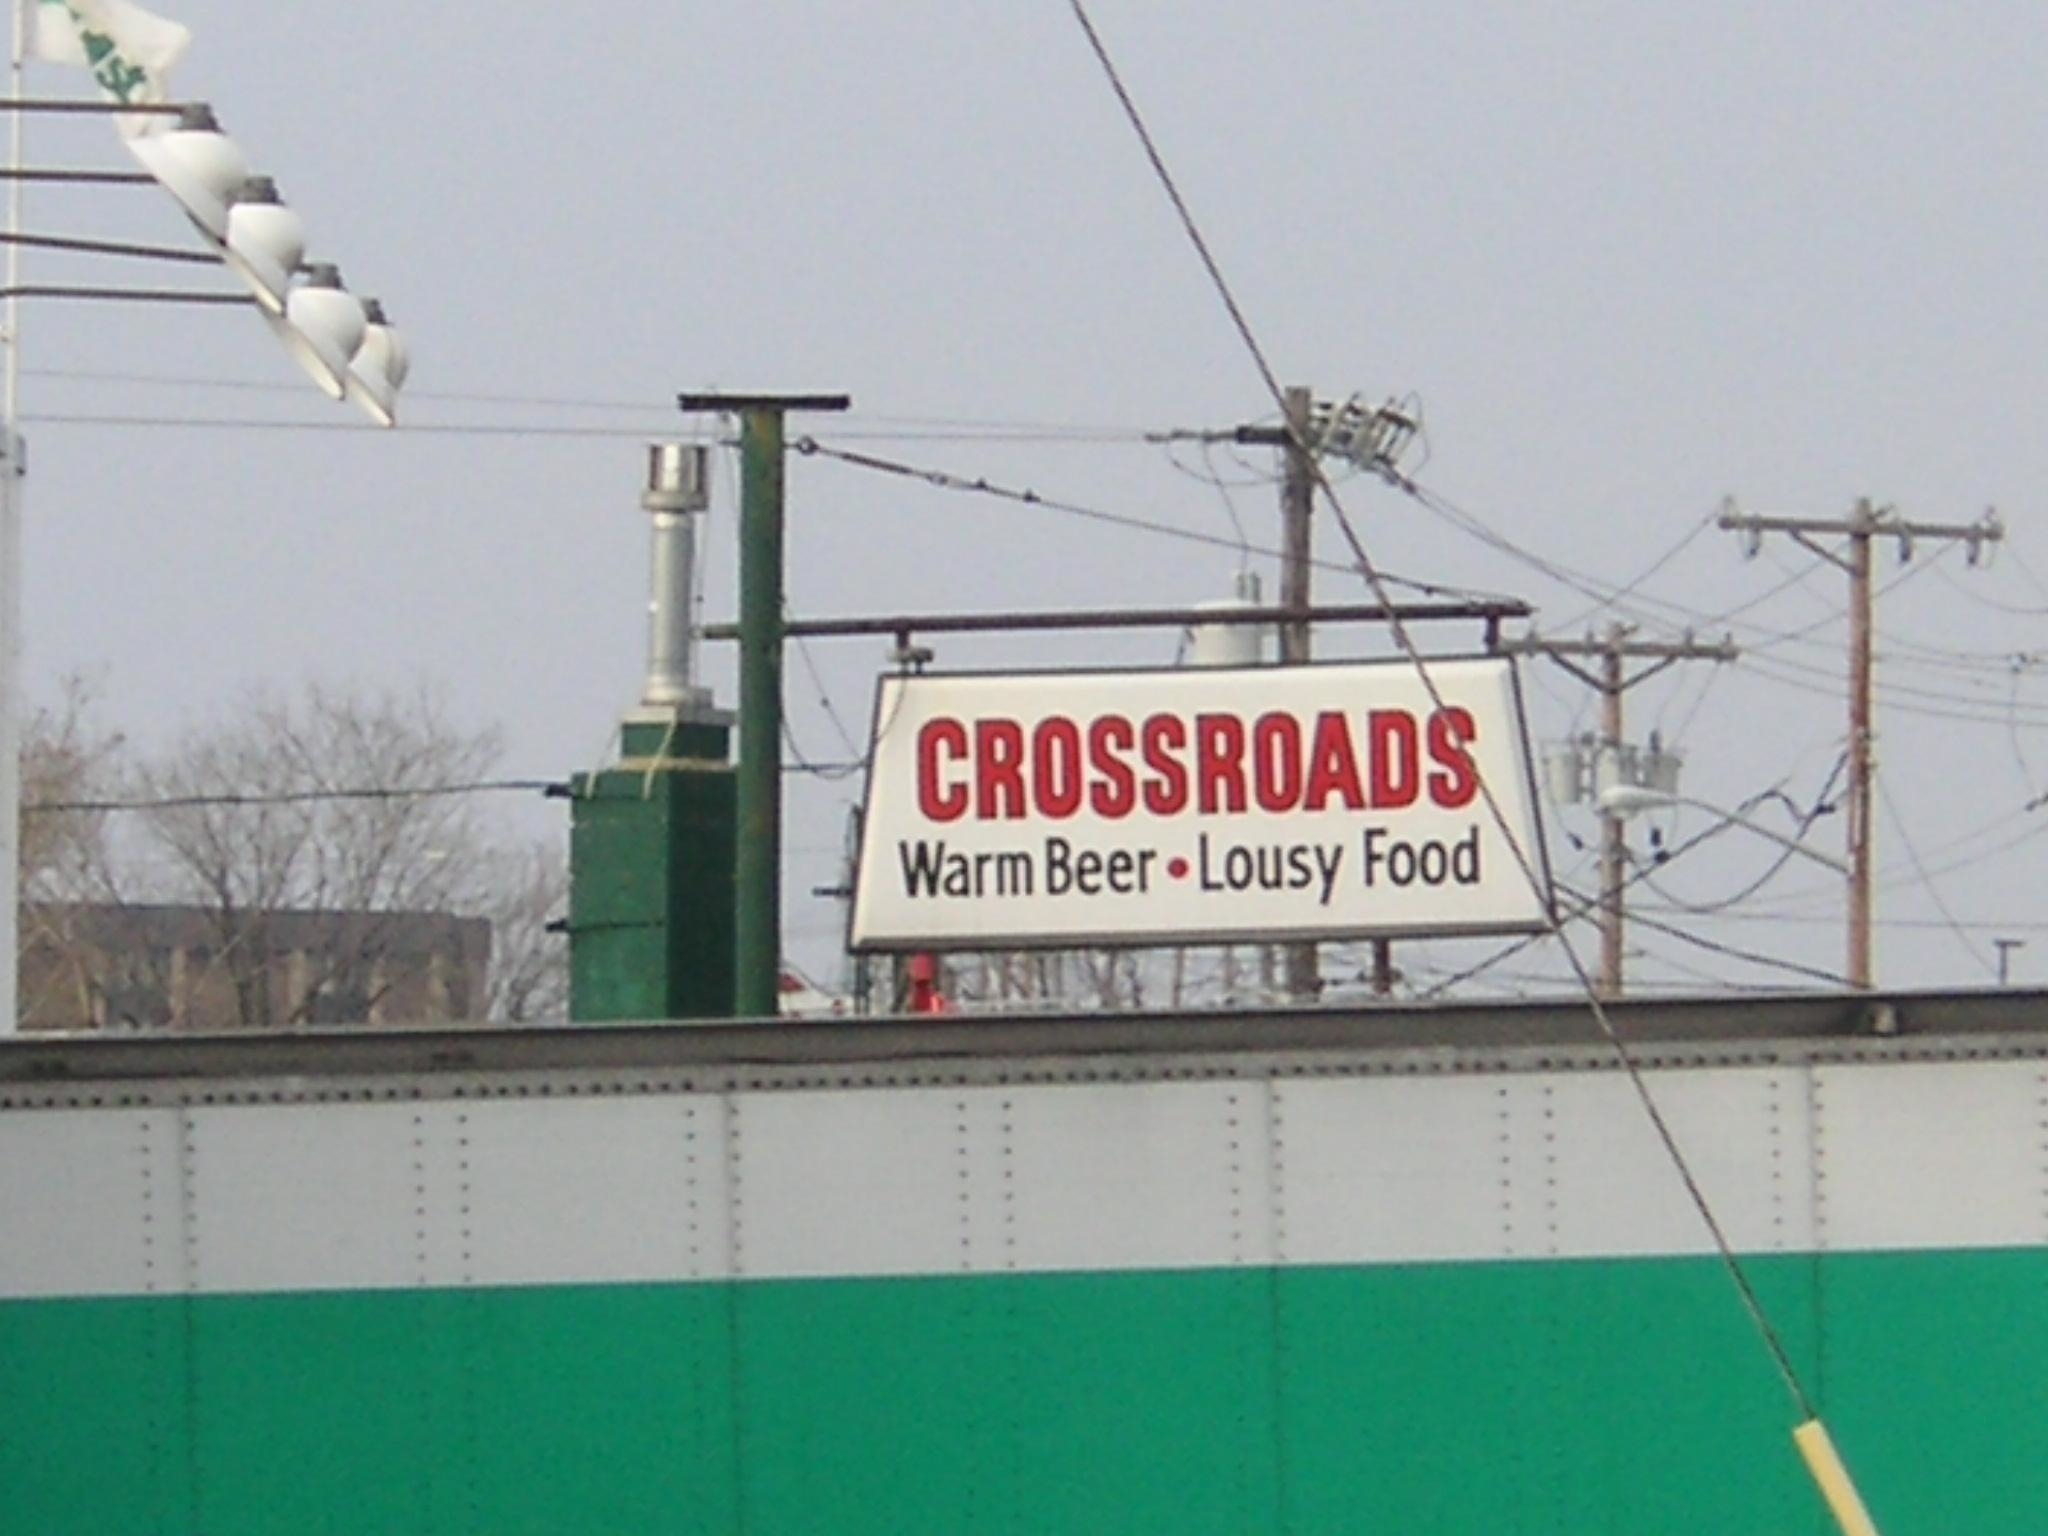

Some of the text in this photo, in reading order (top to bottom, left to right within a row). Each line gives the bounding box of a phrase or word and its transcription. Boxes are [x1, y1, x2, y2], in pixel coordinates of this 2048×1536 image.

[917, 706, 1478, 823] CROSSROADS
[900, 825, 1480, 905] Warm Beer Lousy Food
